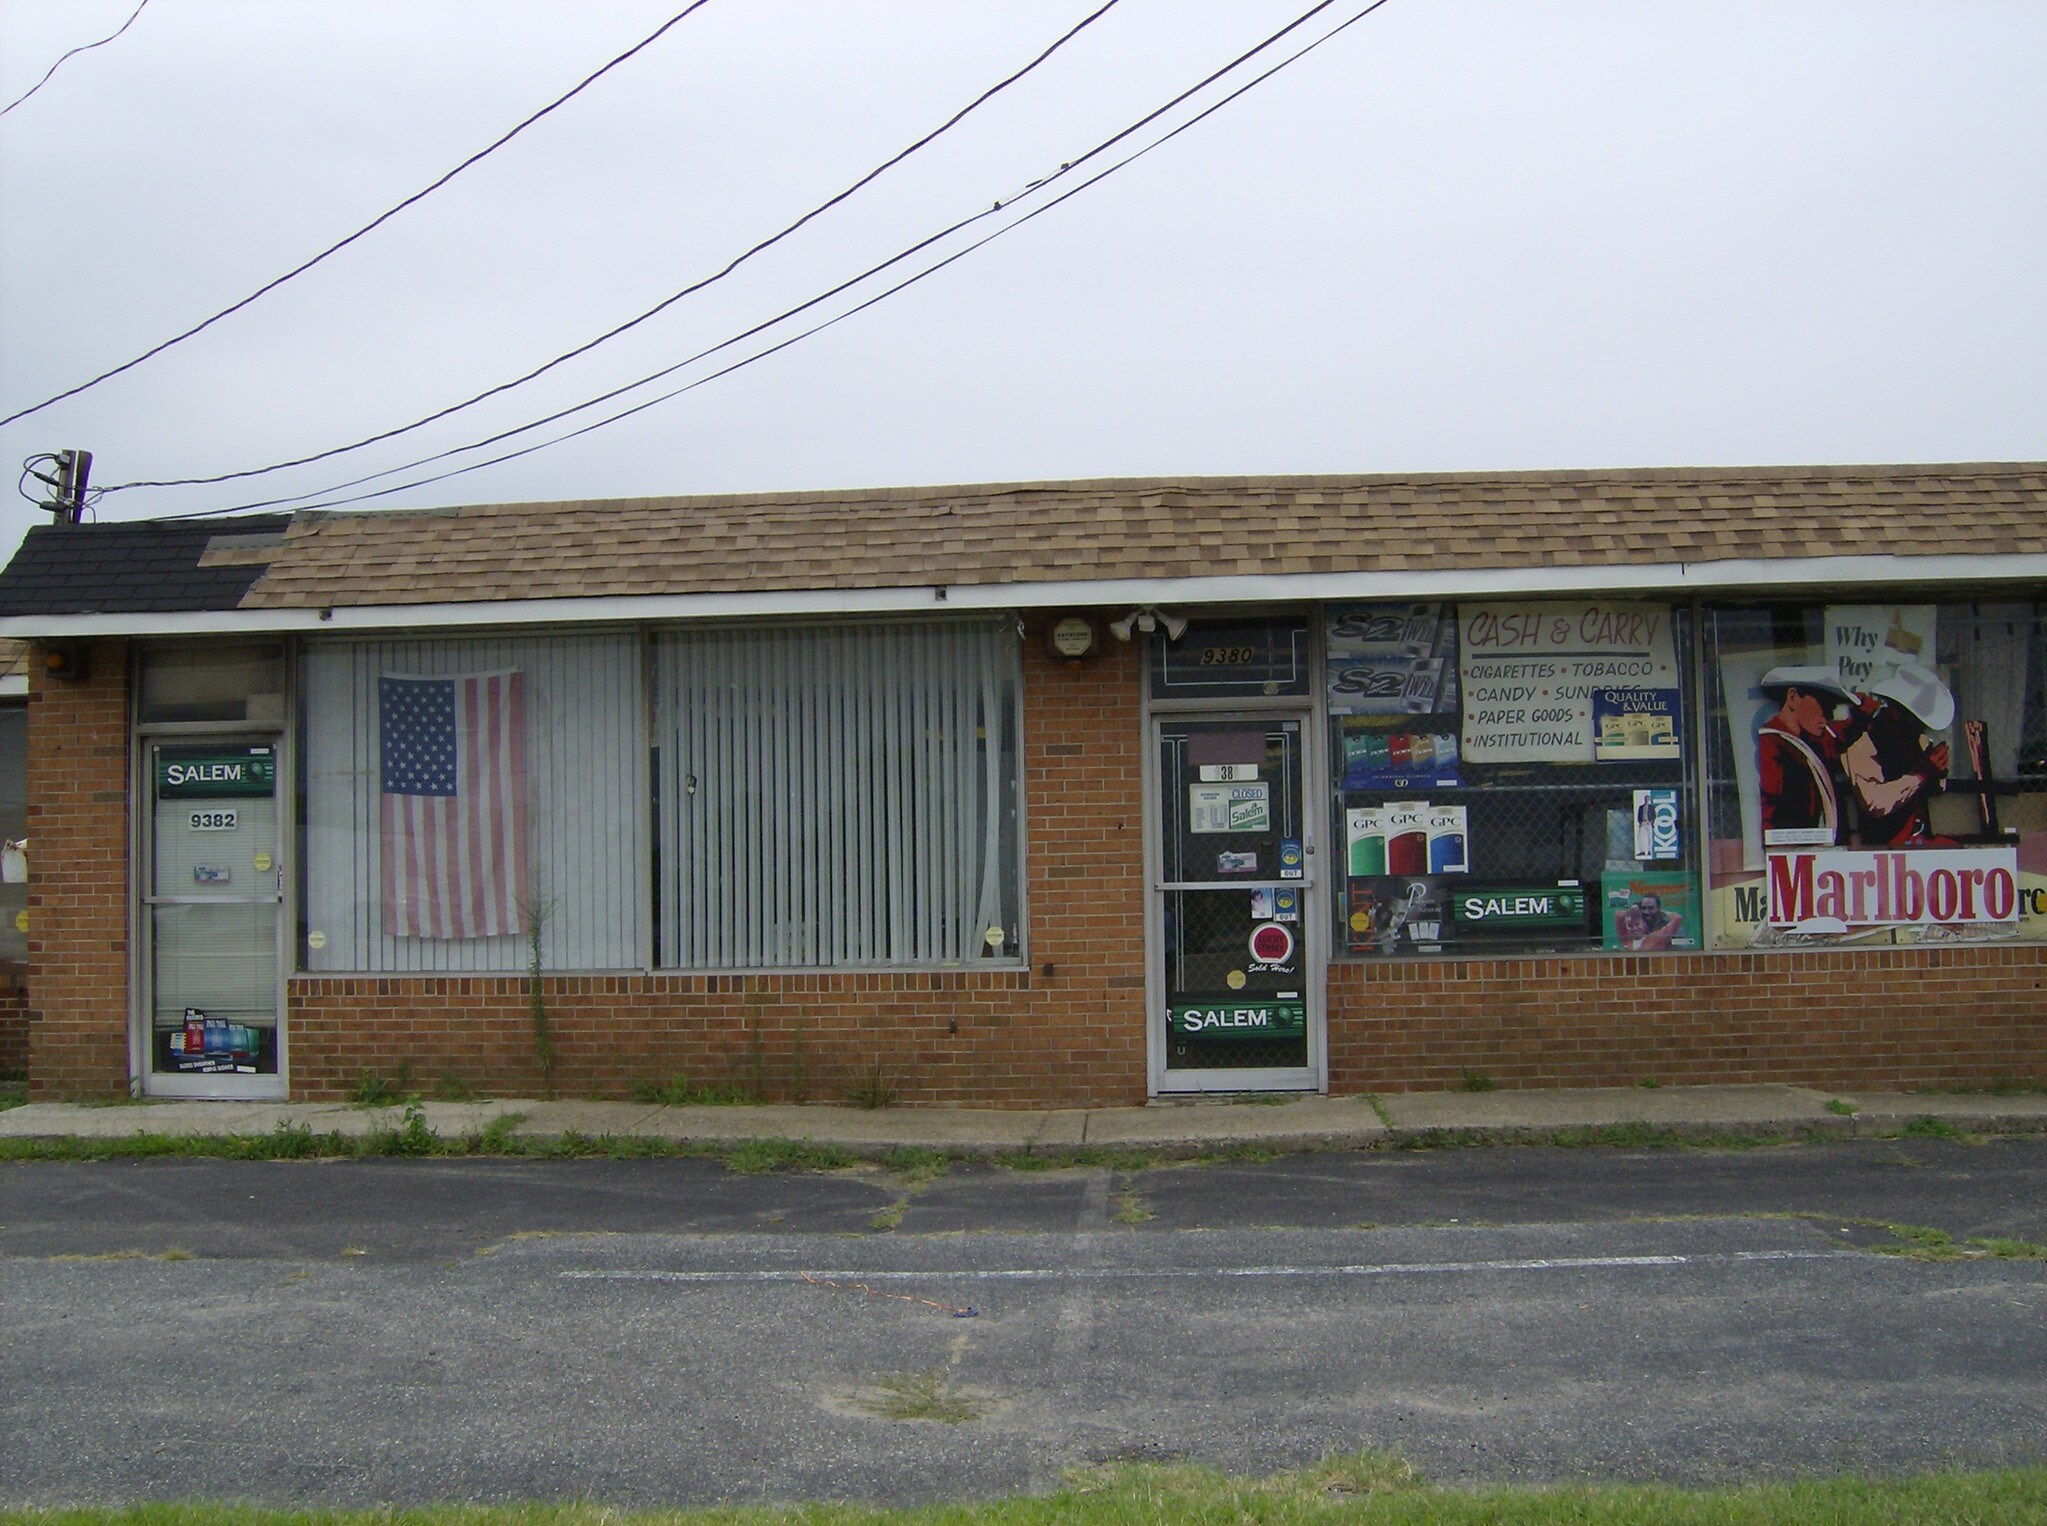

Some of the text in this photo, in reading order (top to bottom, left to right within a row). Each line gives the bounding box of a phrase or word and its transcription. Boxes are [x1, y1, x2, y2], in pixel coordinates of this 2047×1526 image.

[1467, 611, 1542, 646] CASH
[1550, 618, 1570, 645] &
[1579, 607, 1660, 647] CARRY
[1836, 626, 1878, 653] Why
[1203, 648, 1253, 664] 9380
[1470, 662, 1653, 679] CIGARETTES TOBACCO
[1839, 656, 1873, 682] Pay
[1333, 667, 1406, 698] S2
[1476, 686, 1537, 701] CANDY
[1604, 691, 1658, 704] QUALITY
[1477, 708, 1573, 725] PAPER GOODS
[1473, 731, 1583, 748] INSTITUTIONAL
[167, 764, 241, 785] SALEM
[1221, 766, 1234, 780] 38
[1232, 788, 1263, 799] CLOSED
[190, 813, 235, 828] 9382
[1232, 803, 1263, 823] Salem
[1391, 814, 1423, 825] GPC
[1353, 819, 1383, 829] GPC
[1430, 817, 1461, 827] GPC
[1652, 791, 1677, 859] KOOL
[1629, 880, 1689, 897] Newpor
[1768, 853, 2015, 922] Marlboro
[1464, 897, 1548, 920] SALEM
[1248, 963, 1268, 973] Sold
[1183, 1009, 1267, 1031] SALEM
